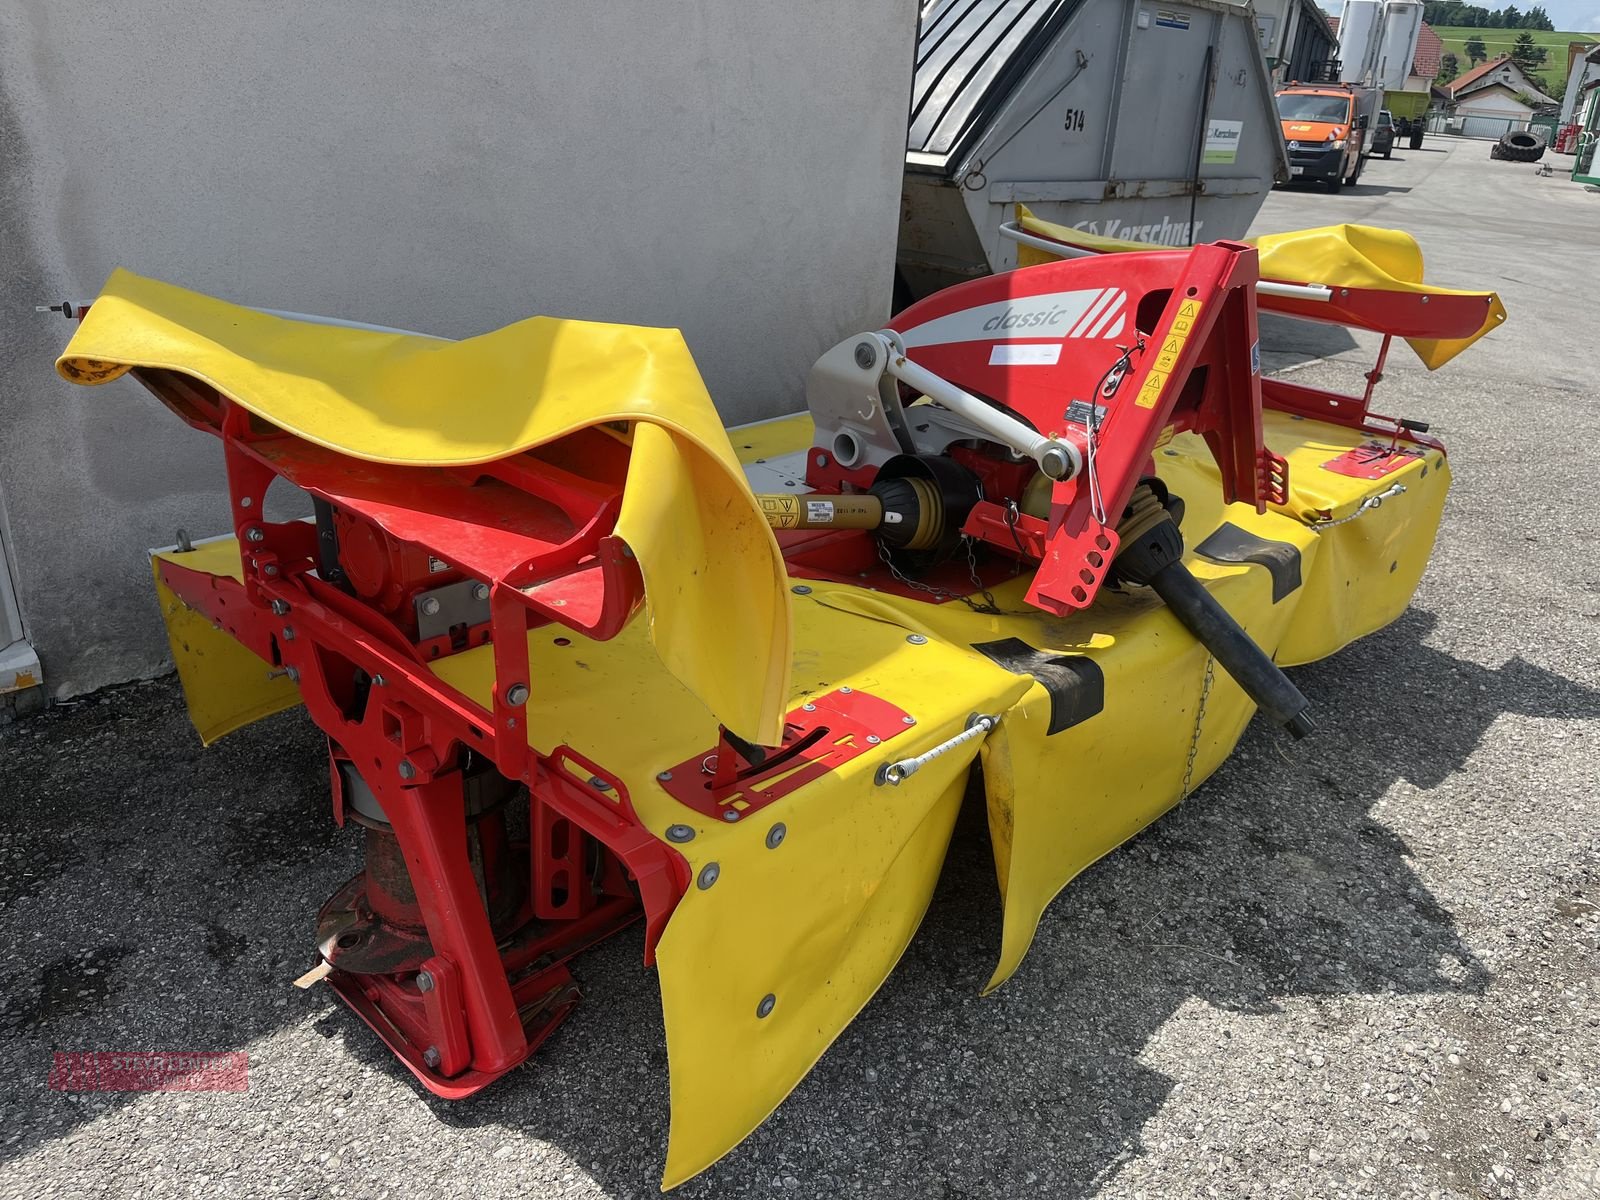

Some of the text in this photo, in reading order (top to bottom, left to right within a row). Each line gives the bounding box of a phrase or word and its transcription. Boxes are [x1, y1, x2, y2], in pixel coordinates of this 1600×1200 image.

[1064, 108, 1085, 132] 514
[1103, 216, 1204, 247] Kerschner
[982, 304, 1068, 332] classic
